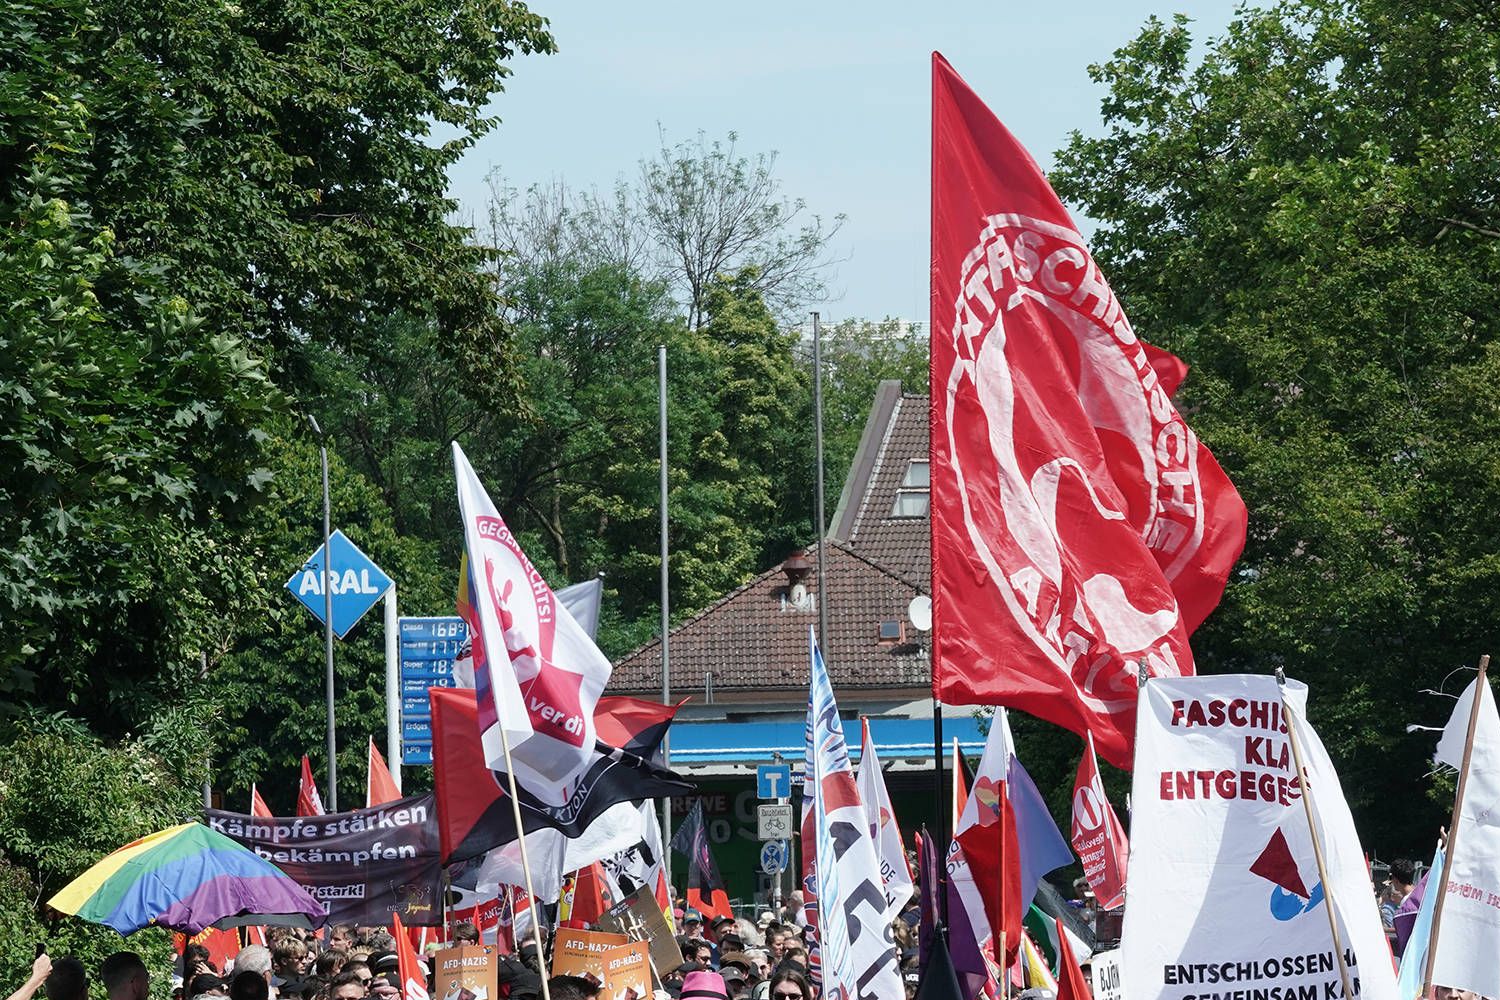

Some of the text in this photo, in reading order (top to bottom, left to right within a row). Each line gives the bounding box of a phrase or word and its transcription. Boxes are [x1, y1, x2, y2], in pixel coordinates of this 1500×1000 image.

[300, 568, 378, 596] ARAL
[403, 661, 423, 670] Super
[406, 723, 427, 731] Erdgas
[530, 697, 584, 737] ver.di
[541, 784, 588, 821] AKTION
[324, 805, 427, 837] stärken
[254, 841, 416, 865] bekämpfen
[319, 884, 364, 897] stark!
[443, 956, 488, 970] AFD-NAZIS
[608, 953, 643, 971] AFD-NAZIS
[1164, 951, 1334, 985] ENTSCHLOSSEN
